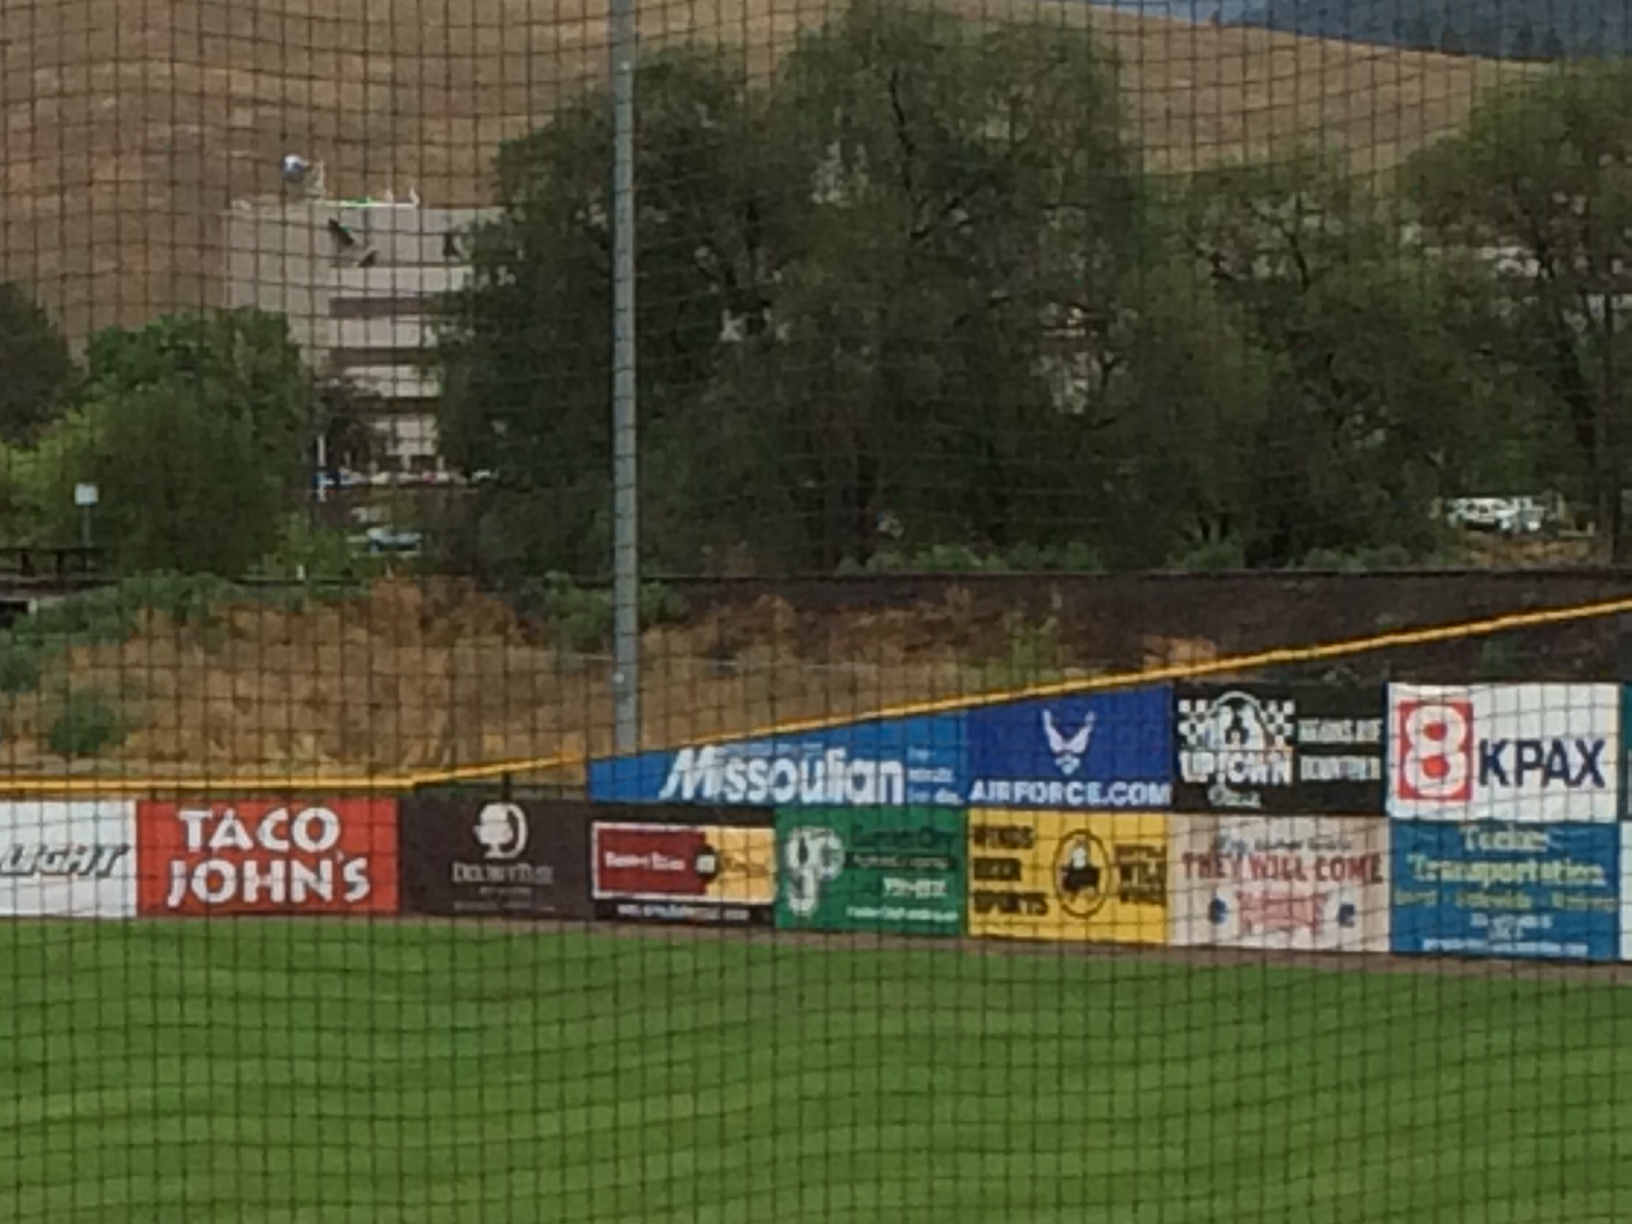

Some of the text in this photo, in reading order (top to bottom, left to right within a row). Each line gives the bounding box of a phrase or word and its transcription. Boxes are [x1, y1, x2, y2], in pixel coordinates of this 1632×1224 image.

[657, 745, 905, 804] Missoulian
[1404, 705, 1606, 797] 8 KPAX
[970, 780, 1171, 806] AIRFORCE.COM
[179, 807, 340, 853] TACO
[167, 851, 370, 908] JOHN'S
[1182, 852, 1244, 881] THEY
[1250, 854, 1308, 881] WILL
[1316, 854, 1383, 884] COME
